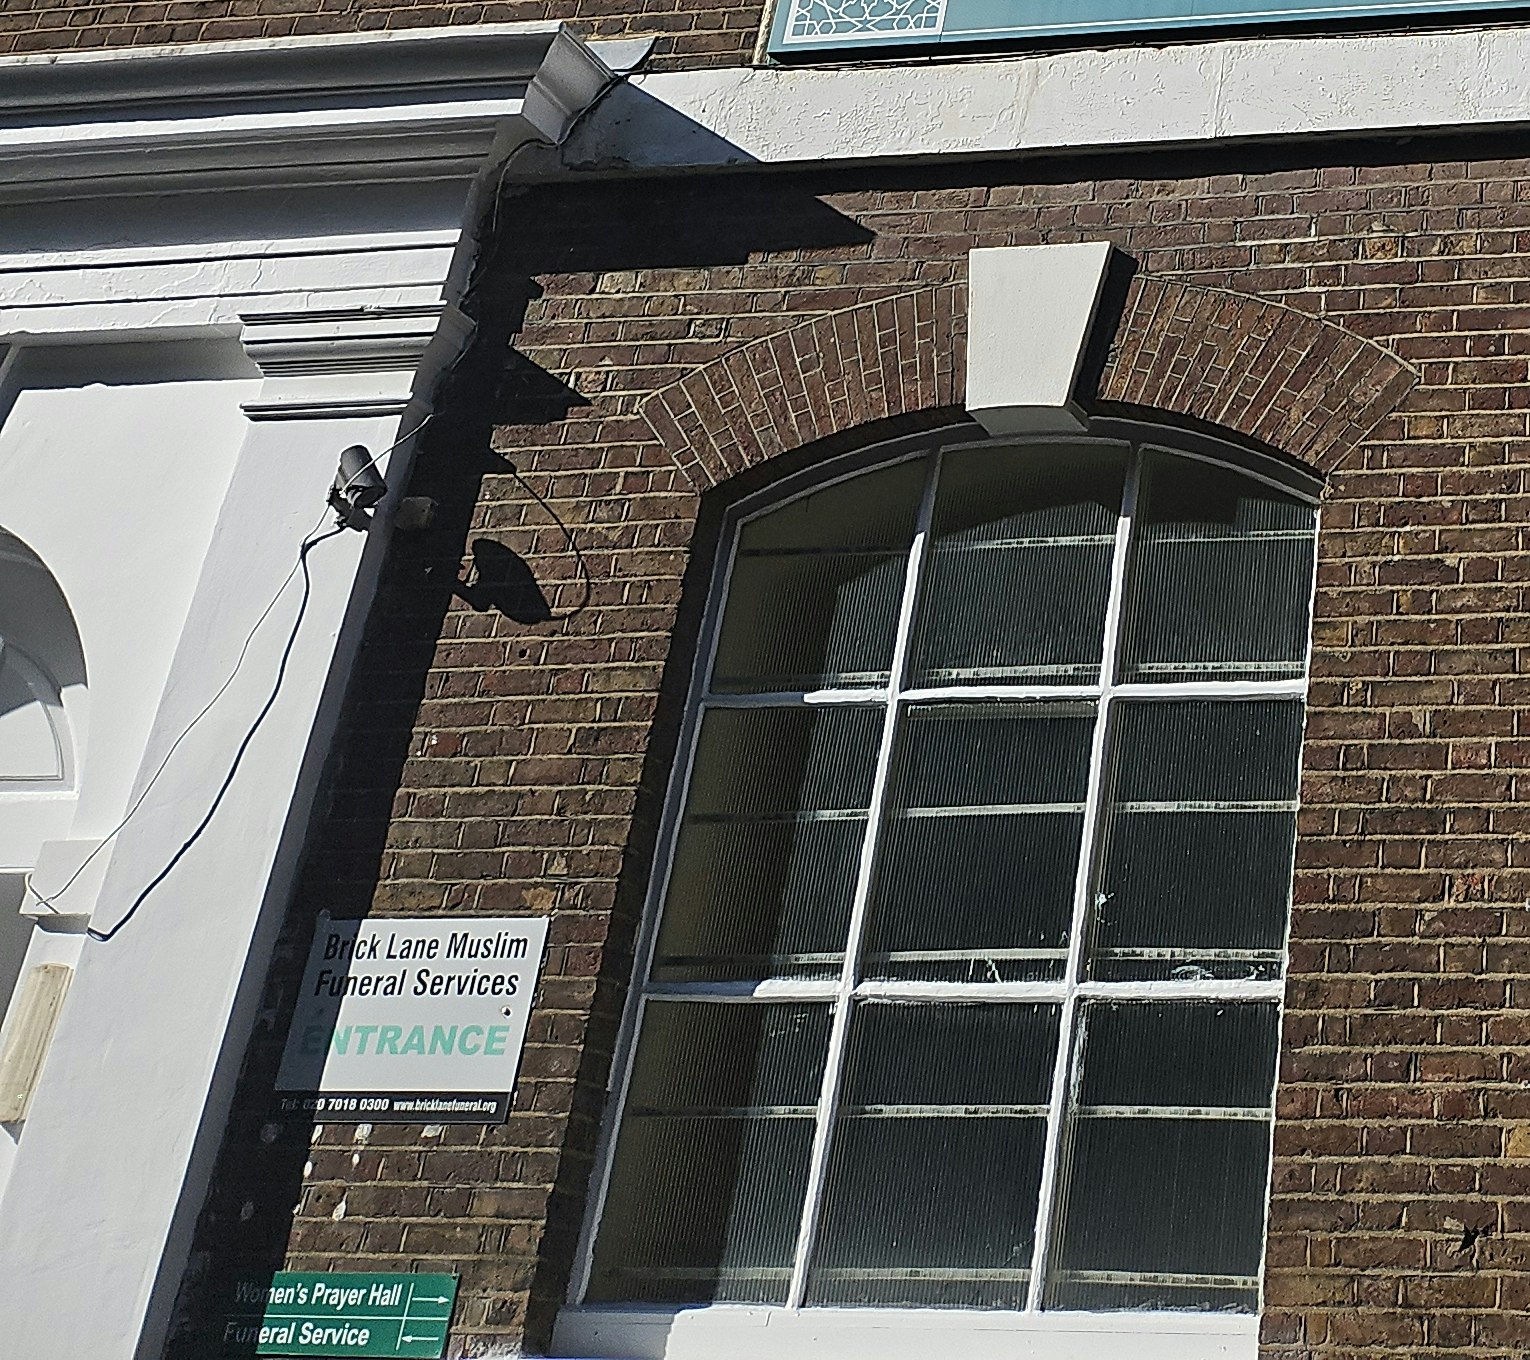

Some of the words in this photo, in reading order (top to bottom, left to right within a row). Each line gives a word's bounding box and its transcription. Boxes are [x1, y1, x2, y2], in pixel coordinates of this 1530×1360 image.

[323, 932, 382, 961] Brick
[385, 932, 439, 960] Lane
[446, 931, 529, 959] Muslim
[313, 968, 407, 997] Funeral
[413, 968, 520, 996] Services
[299, 1024, 511, 1056] ENTRANCE
[327, 1098, 357, 1111] 7018
[359, 1098, 389, 1111] 0300
[234, 1281, 309, 1304] Women's
[310, 1282, 367, 1311] Prayer
[368, 1283, 403, 1306] Hall
[222, 1321, 297, 1345] Funeral
[298, 1322, 370, 1346] Service
